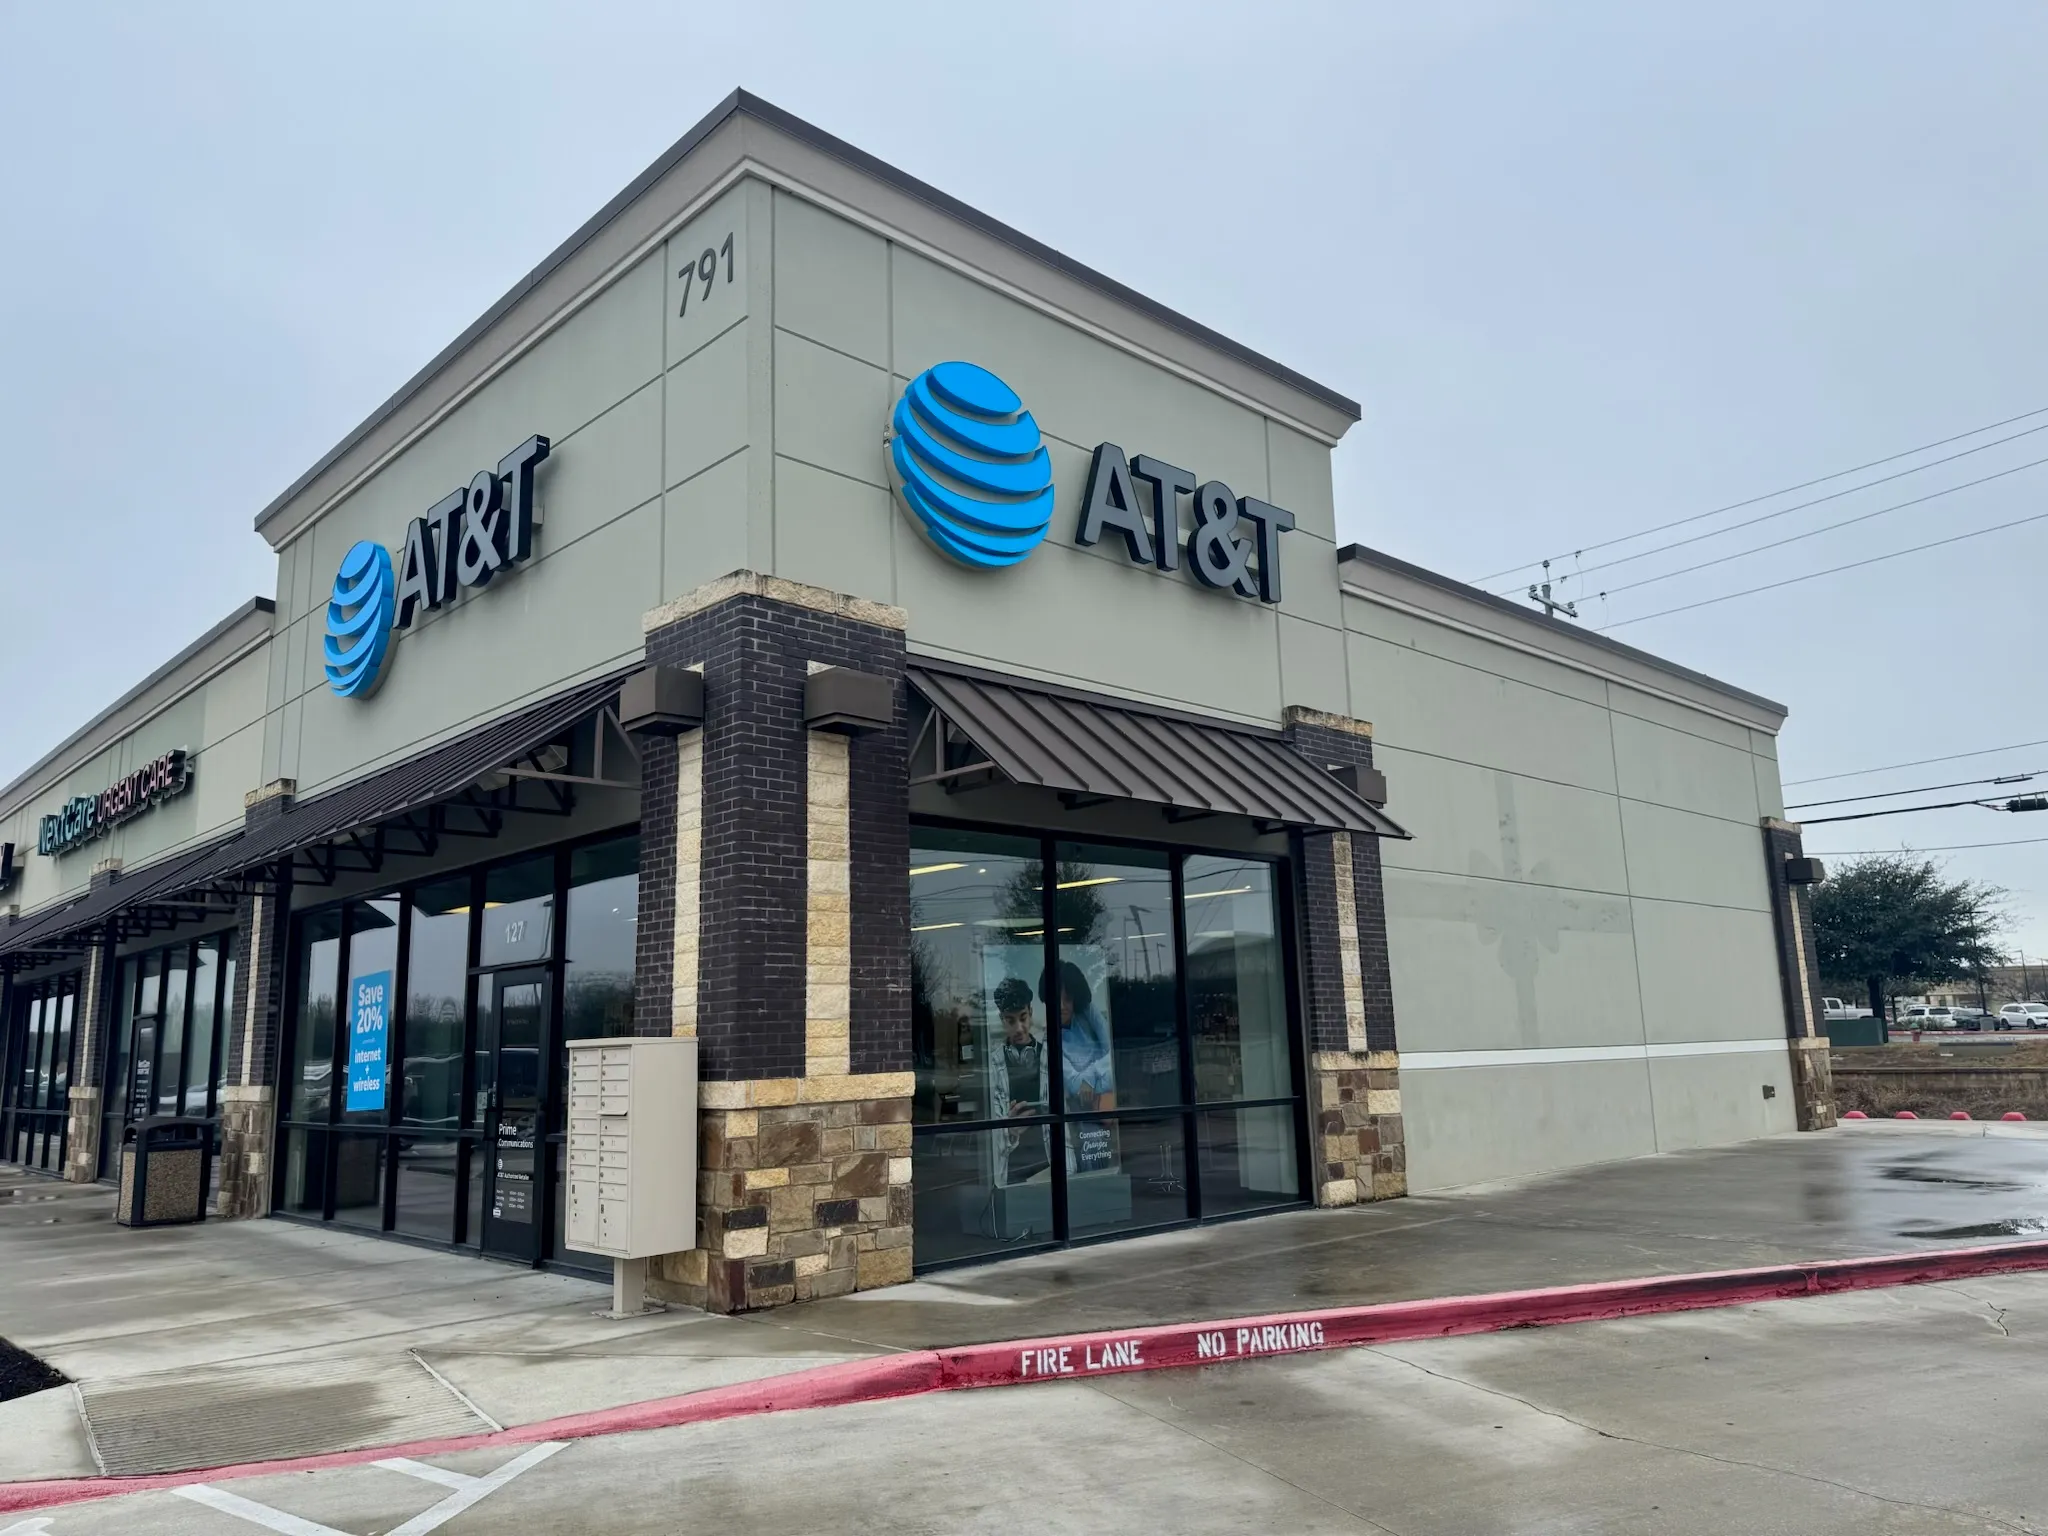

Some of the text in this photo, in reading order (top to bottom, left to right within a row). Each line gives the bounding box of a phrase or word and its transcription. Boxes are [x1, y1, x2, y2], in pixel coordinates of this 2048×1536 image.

[678, 231, 735, 318] 791
[394, 434, 550, 630] AT&T
[1075, 441, 1296, 604] AT&T
[38, 749, 181, 856] NextCare URGENT CARE
[505, 920, 524, 944] 127
[358, 983, 384, 1007] Save
[356, 1005, 383, 1034] 20%
[354, 1047, 382, 1064] internet
[353, 1076, 380, 1092] wireless
[498, 1122, 517, 1136] Prime
[1079, 1129, 1110, 1139] Connecting
[497, 1138, 534, 1149] Communications
[1081, 1150, 1112, 1161] Everything
[1020, 1321, 1325, 1377] FIRE LANE NO PARKING
